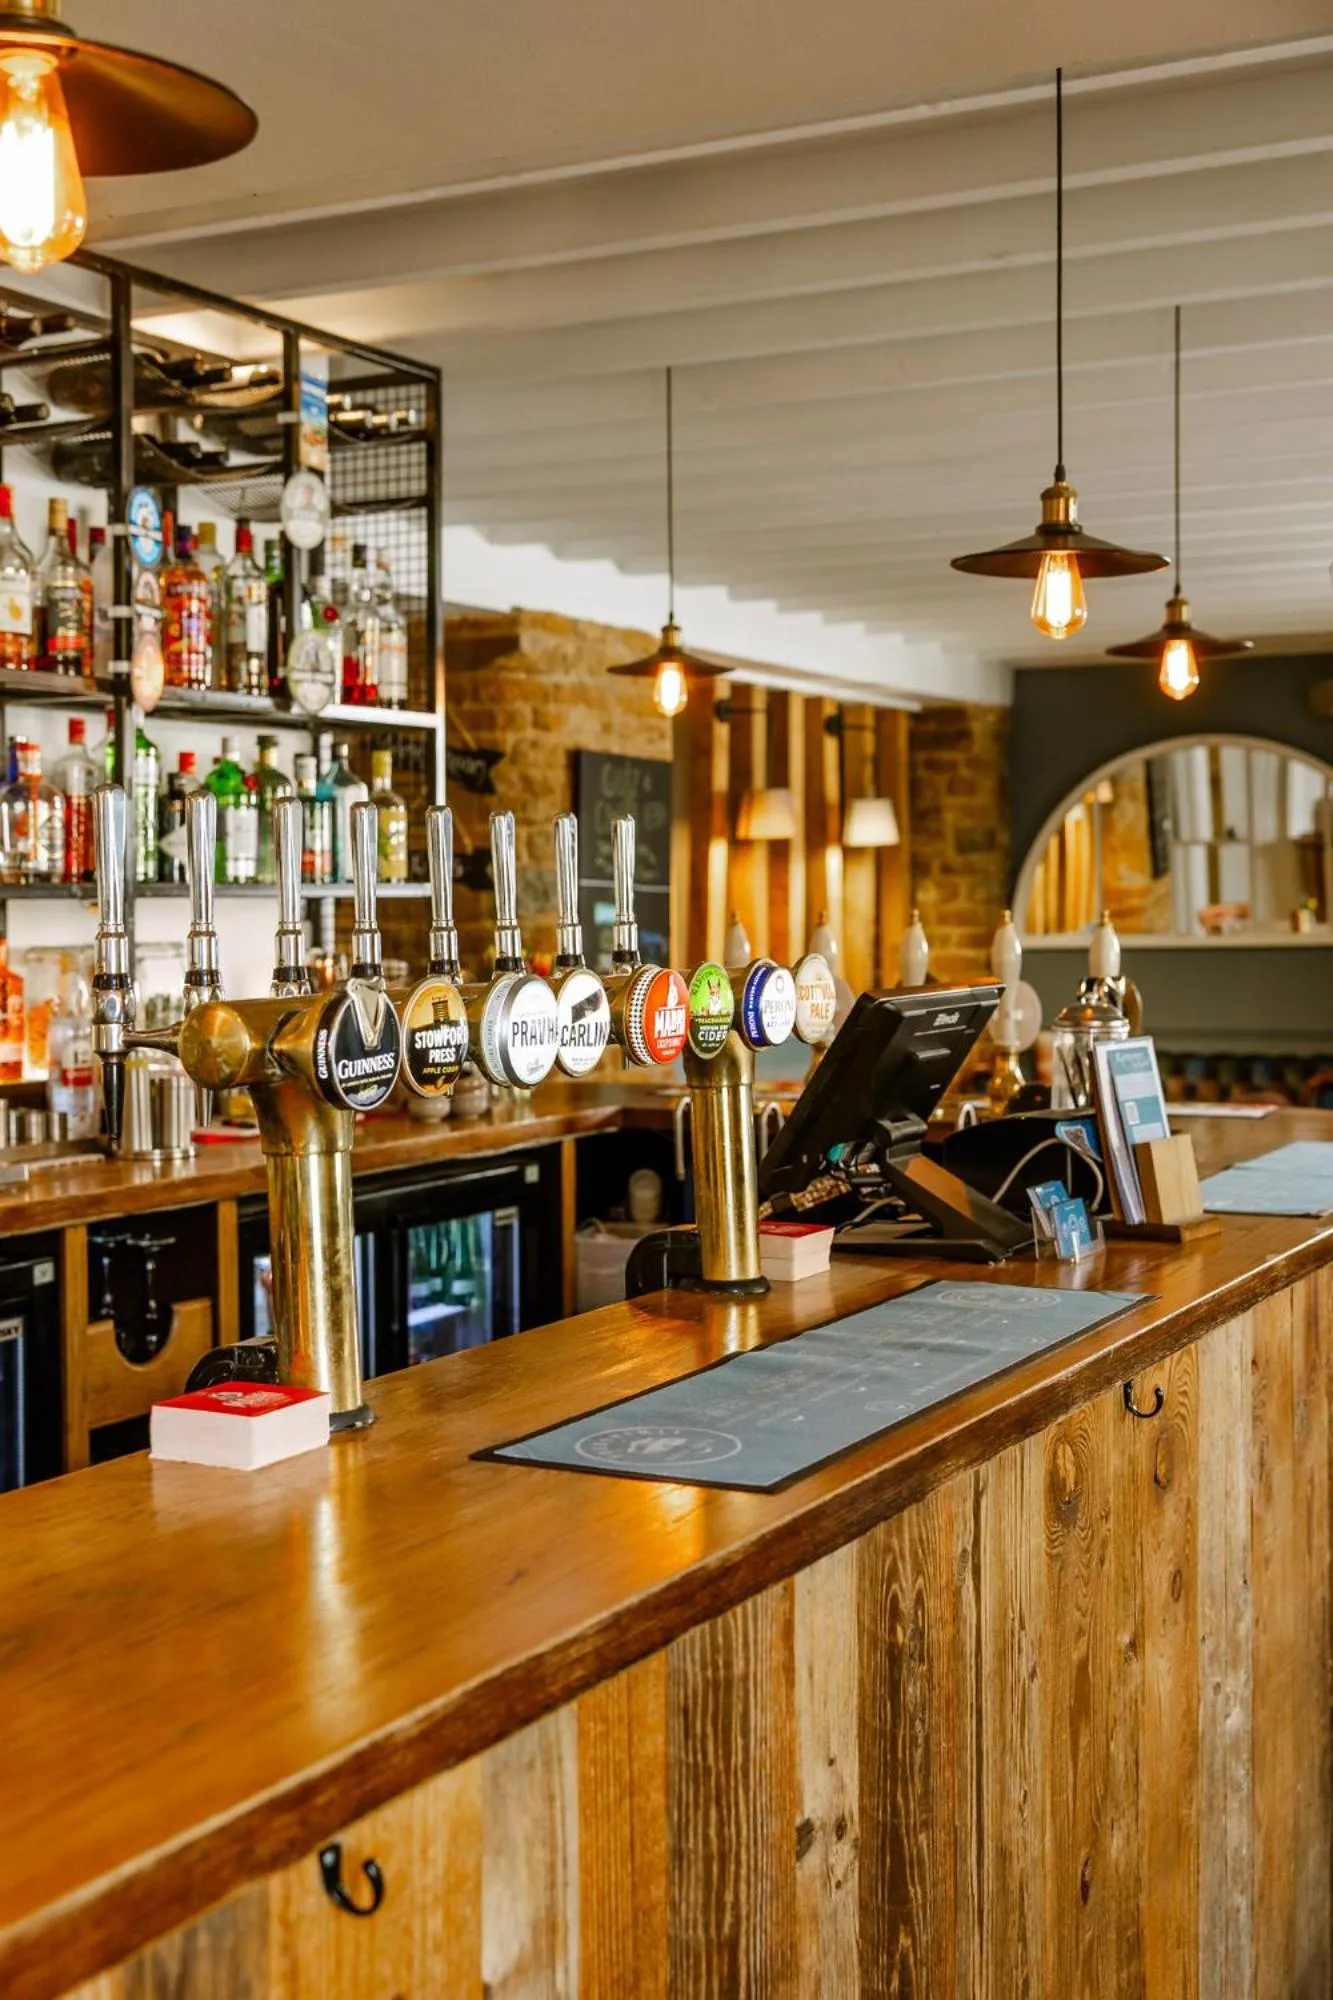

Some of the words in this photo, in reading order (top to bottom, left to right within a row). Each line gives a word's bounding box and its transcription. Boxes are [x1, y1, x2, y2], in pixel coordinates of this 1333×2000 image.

[560, 1022, 608, 1048] CARLIN
[698, 1030, 729, 1042] CIDER
[316, 1028, 329, 1080] GUINNESS
[338, 1052, 396, 1080] GUINNESS
[428, 1047, 457, 1064] PRESS
